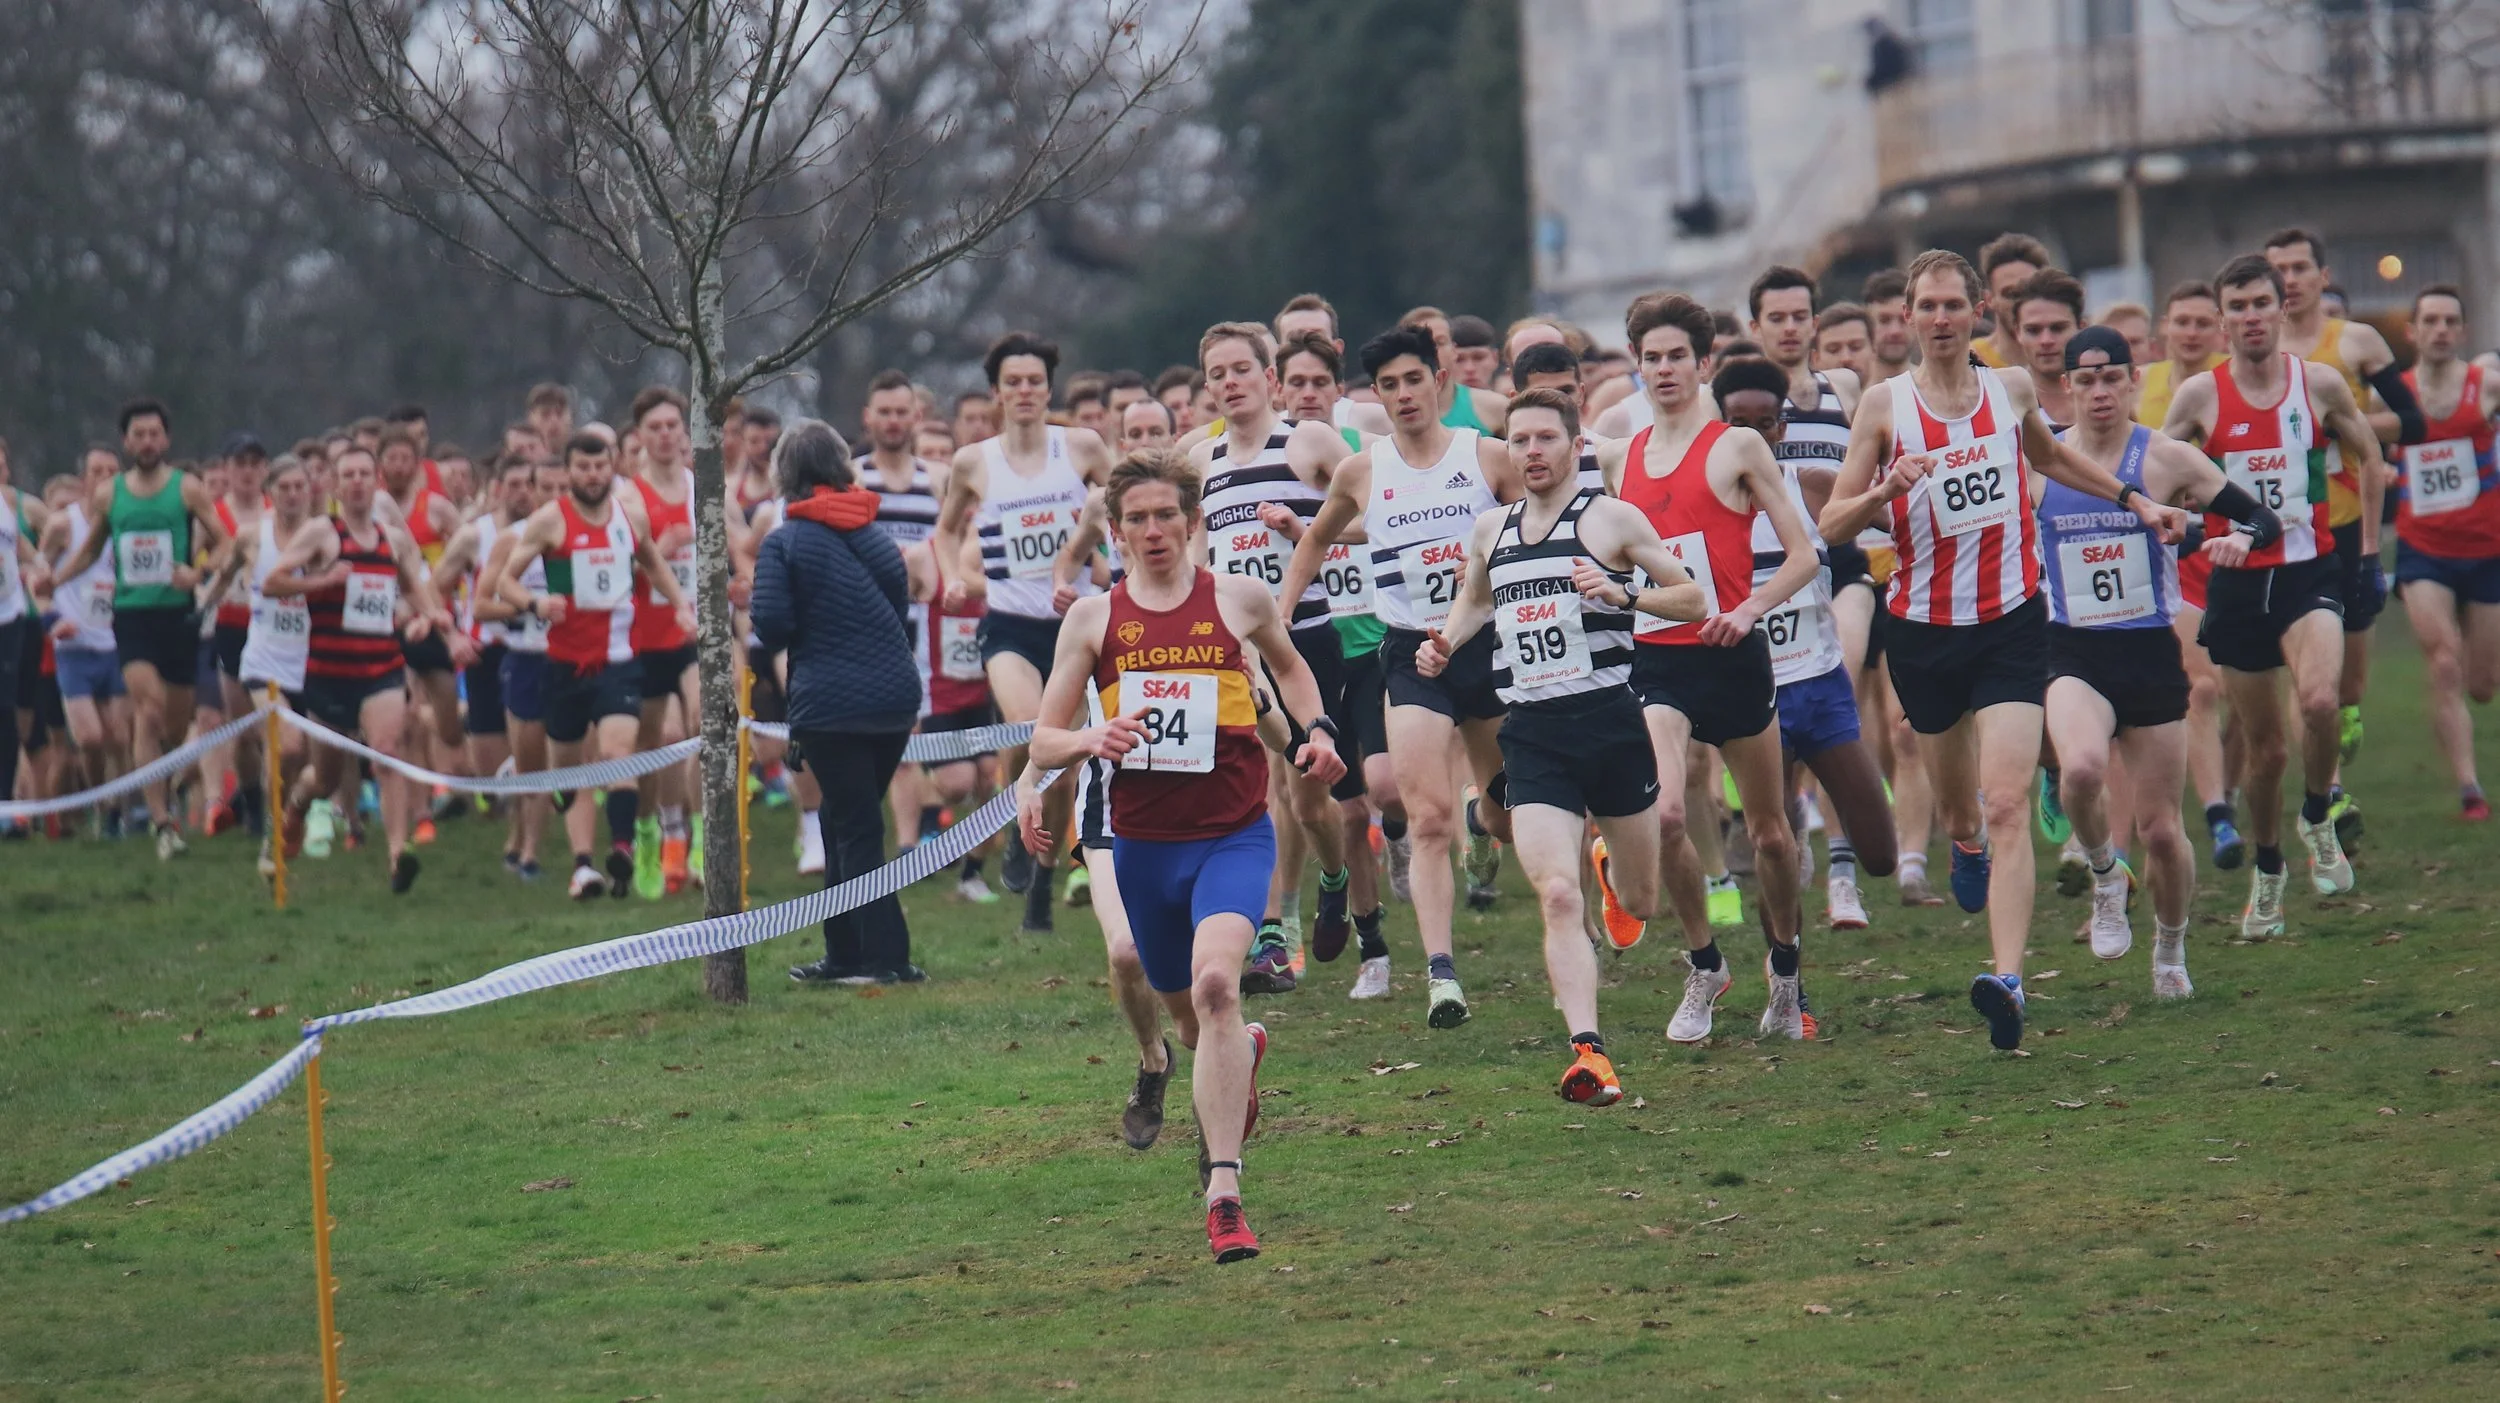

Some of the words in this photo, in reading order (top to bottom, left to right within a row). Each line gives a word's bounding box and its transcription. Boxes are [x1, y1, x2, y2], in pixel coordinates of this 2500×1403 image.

[1944, 444, 1989, 469] SEAA
[2126, 445, 2141, 475] soar
[2247, 454, 2287, 472] SEAA
[1209, 474, 1232, 490] soar
[1445, 480, 1473, 490] adidas
[1943, 467, 2005, 511] 862
[2420, 465, 2462, 495] 316
[997, 494, 1057, 512] TONBRIDGE
[2255, 478, 2285, 510] 13
[1020, 510, 1055, 528] SEAA
[1387, 504, 1471, 528] CROYDON
[1949, 508, 2013, 530] www.seaa.org.uk
[2053, 511, 2138, 531] BEDFORD
[1231, 531, 1270, 551] SEAA
[1421, 541, 1464, 565] SEAA
[2082, 543, 2126, 563] SEAA
[597, 569, 610, 592] 8
[2092, 567, 2126, 602] 61
[1495, 579, 1584, 606] HIGHGAT
[1516, 601, 1557, 623] SEAA
[2079, 605, 2145, 622] www.seaa.org.uk
[1755, 610, 1800, 645] 67
[1517, 626, 1567, 665] 519
[1115, 645, 1225, 673] BELGRAVE
[1142, 680, 1191, 700] SEAA
[1144, 707, 1189, 745] 84
[1126, 756, 1202, 767] www.seaa.org.uk
